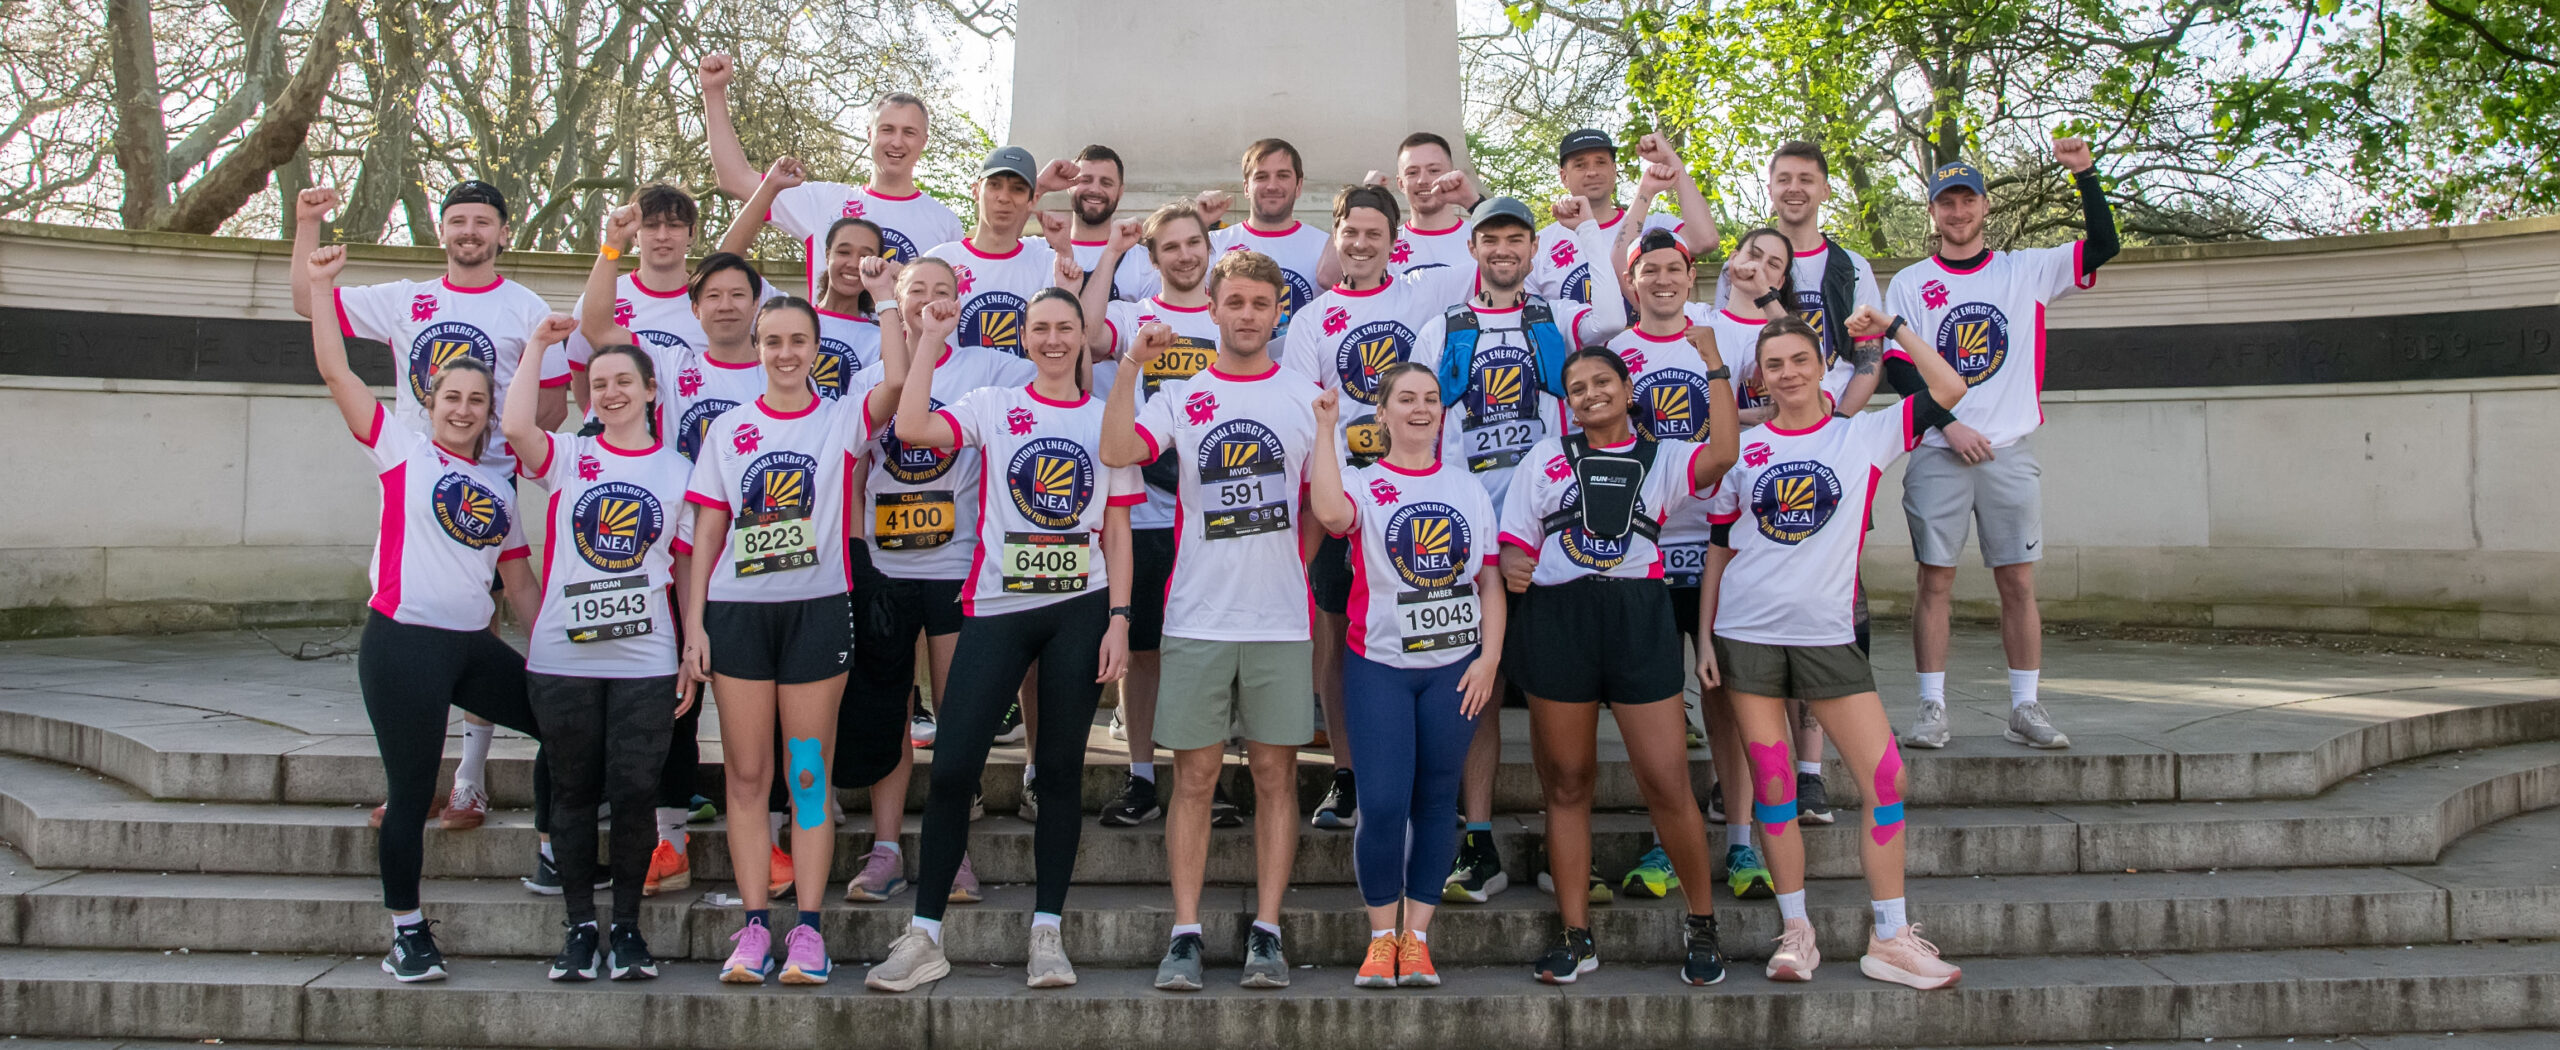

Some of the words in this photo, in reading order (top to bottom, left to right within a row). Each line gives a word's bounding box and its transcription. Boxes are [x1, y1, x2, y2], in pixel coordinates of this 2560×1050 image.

[1938, 167, 1969, 181] SUFC
[882, 230, 905, 244] ERGY
[901, 242, 918, 260] ACTI
[960, 297, 986, 333] NATIONAL
[986, 294, 1020, 307] ENERGY
[1960, 305, 1992, 317] ENERGY
[411, 326, 442, 360] NATIONAL
[443, 324, 479, 339] ENERGY
[474, 334, 494, 366] ACTION
[1174, 337, 1193, 345] AROL
[1338, 331, 1363, 369] NATIONAL
[1362, 322, 1395, 336] ENERGY
[1394, 325, 1416, 347] ACTIO
[820, 339, 848, 353] NERGY
[844, 350, 861, 376] ACTIO
[1153, 351, 1207, 371] 3079
[1489, 349, 1526, 361] ENERGY
[1960, 355, 1986, 370] NEA
[820, 386, 838, 400] EA
[1632, 377, 1657, 402] TIONAL
[1656, 370, 1691, 380] ENERGY
[1482, 411, 1519, 424] MATTHEW
[1657, 420, 1690, 433] NEA
[1199, 426, 1230, 467] NATIONAL
[1230, 422, 1265, 437] ENERGY
[1476, 424, 1533, 452] 2122
[903, 450, 933, 464] NEA
[1010, 441, 1046, 474] NATIONAL
[1046, 440, 1082, 456] ENERGY
[1078, 453, 1093, 487] ACTION
[742, 456, 773, 493] NATIONAL
[773, 453, 808, 465] ENERGY
[913, 468, 938, 481] WARM
[1229, 466, 1254, 477] MVDL
[1753, 468, 1783, 503] NATIONAL
[1782, 462, 1818, 473] ENERGY
[1816, 467, 1840, 496] ACTION
[901, 493, 923, 502] CELIA
[1035, 493, 1069, 510] NEA
[1221, 481, 1264, 506] 591
[436, 502, 454, 530] ACTION
[575, 485, 610, 517] NATIONAL
[611, 484, 647, 498] ENERGY
[644, 496, 662, 529] ACTION
[1012, 488, 1033, 516] ACTION
[1031, 511, 1047, 525] FOR
[1778, 510, 1811, 523] NEA
[458, 511, 485, 534] NEA
[886, 507, 942, 530] 4100
[1388, 506, 1417, 542] NATIONAL
[1415, 503, 1451, 515] ENERGY
[1451, 511, 1471, 544] ACTION
[598, 535, 632, 551] NEA
[745, 525, 804, 554] 8223
[1028, 534, 1066, 543] GEORGIA
[1583, 536, 1618, 552] NEA
[576, 532, 595, 559] ACTION
[592, 555, 608, 568] FOR
[608, 558, 634, 569] WARM
[1016, 550, 1077, 572] 6408
[1417, 554, 1451, 569] NEA
[1562, 533, 1581, 560] ACTION
[1595, 557, 1624, 568] WARM
[1394, 555, 1414, 582] ACTION
[1414, 576, 1431, 588] FOR
[590, 580, 622, 591] MEGAN
[1427, 588, 1453, 600] AMBER
[571, 593, 647, 622] 19543
[1406, 602, 1474, 631] 19043
